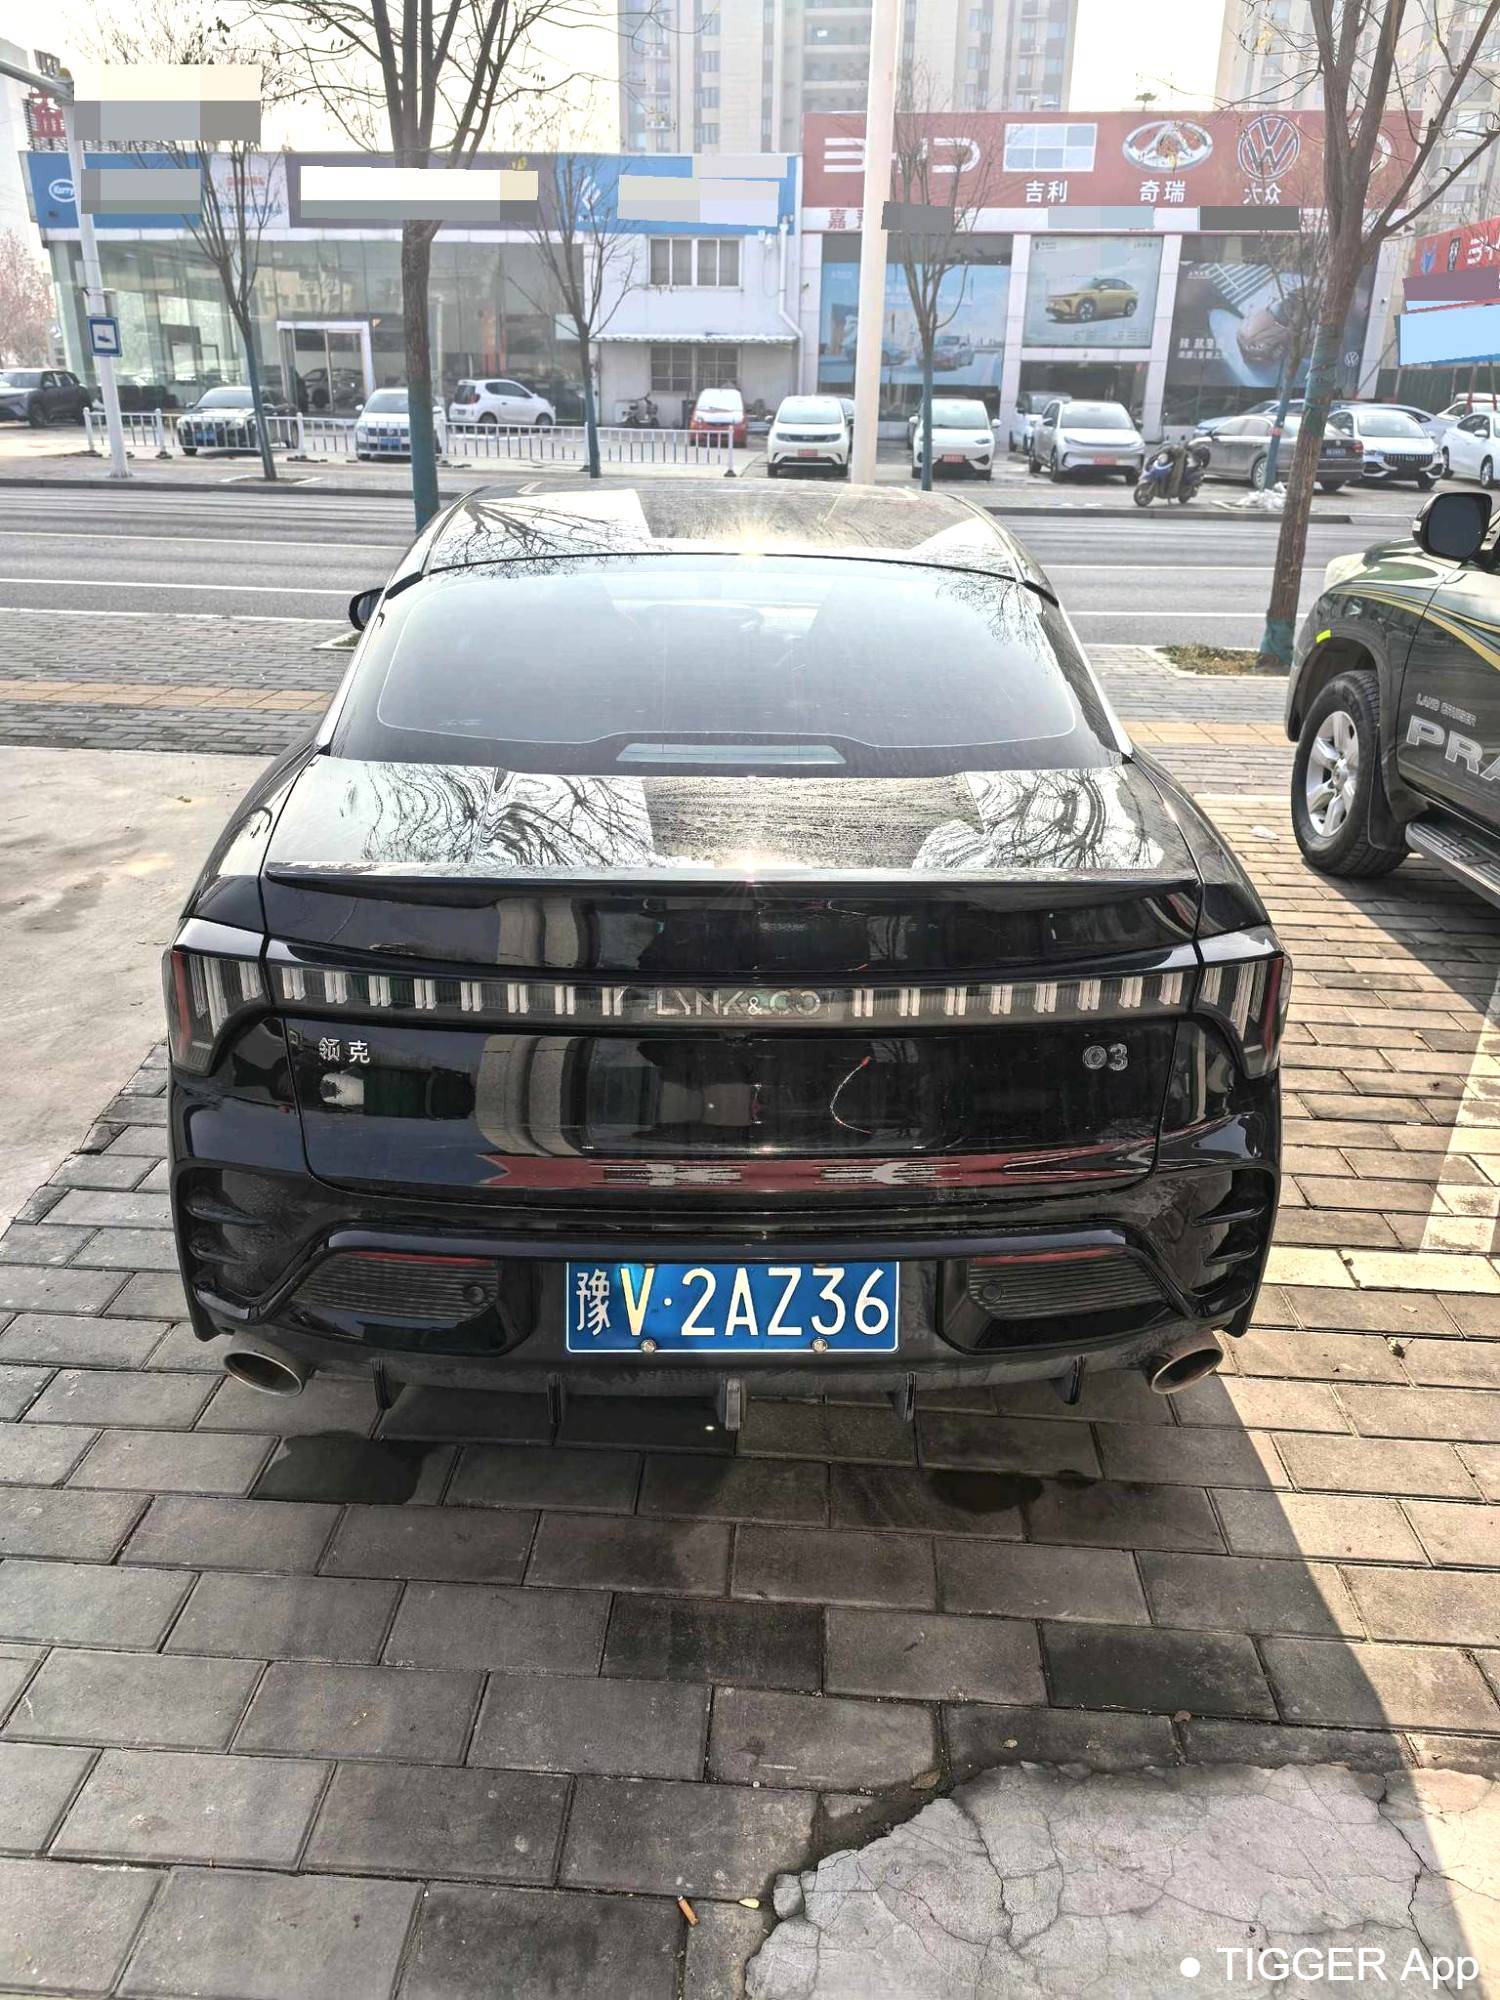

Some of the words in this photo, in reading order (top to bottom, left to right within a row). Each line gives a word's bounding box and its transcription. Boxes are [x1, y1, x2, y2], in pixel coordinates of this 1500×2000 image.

[1025, 180, 1068, 203] 吉利
[1139, 180, 1186, 203] 奇瑞
[1243, 182, 1282, 205] 大众
[318, 1037, 371, 1064] 领克
